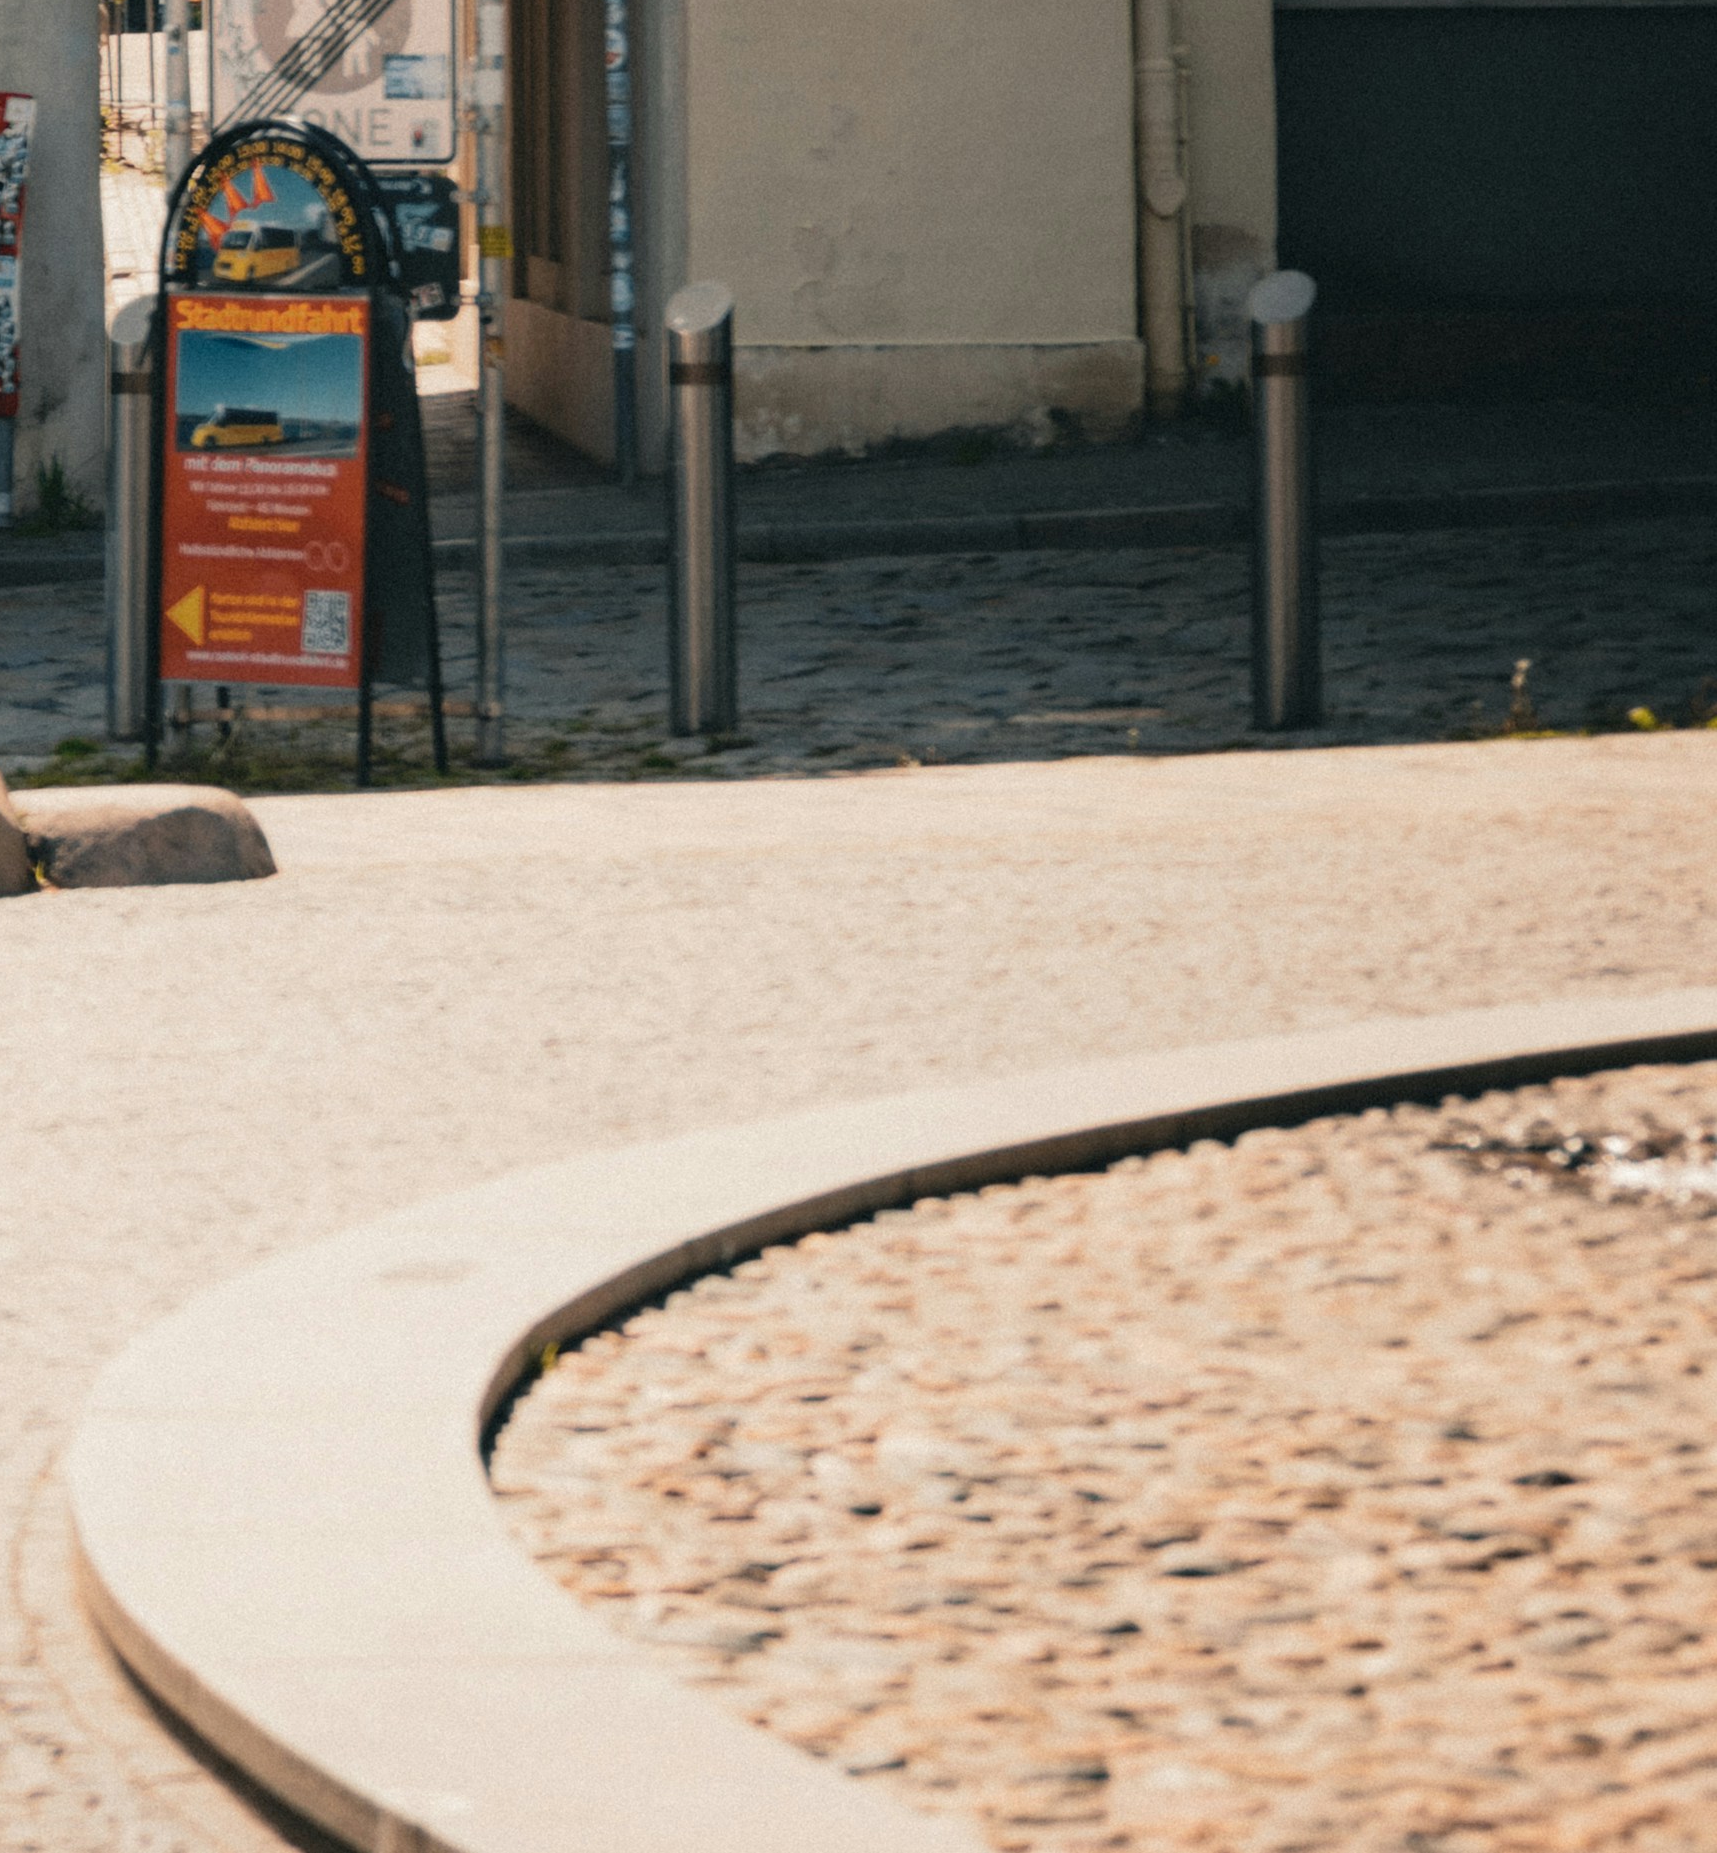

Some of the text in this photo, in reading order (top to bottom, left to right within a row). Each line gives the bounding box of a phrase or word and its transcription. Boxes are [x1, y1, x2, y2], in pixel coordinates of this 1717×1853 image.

[175, 299, 364, 334] Stadtrundfahrt
[183, 455, 206, 471] mit
[210, 456, 240, 473] dem
